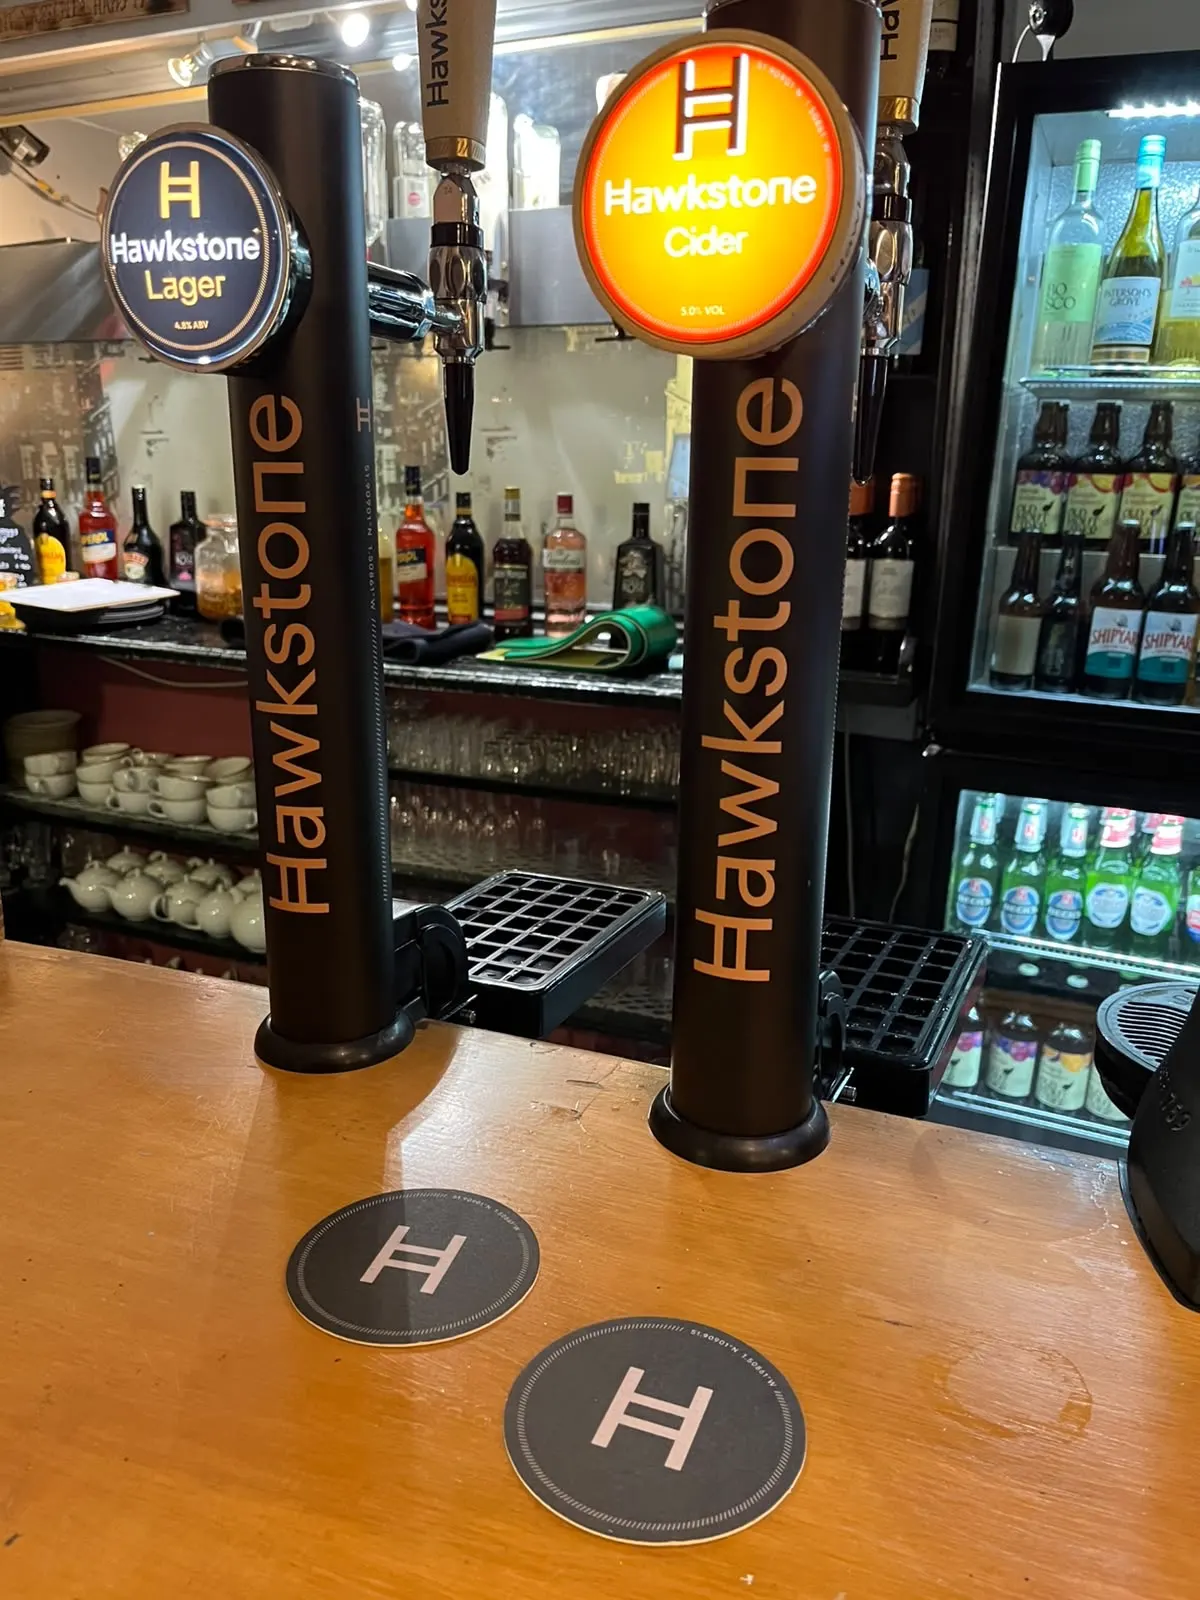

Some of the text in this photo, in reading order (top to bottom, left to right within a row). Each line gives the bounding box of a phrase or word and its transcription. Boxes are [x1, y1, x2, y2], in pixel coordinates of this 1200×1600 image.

[604, 173, 817, 216] Hawkstone
[110, 229, 260, 264] Hawkstone
[664, 225, 749, 258] Cider
[144, 270, 226, 306] Lager
[193, 320, 209, 330] ABV
[704, 304, 726, 316] VOL
[249, 393, 330, 914] Hawkstone
[693, 377, 803, 982] Hawkstone
